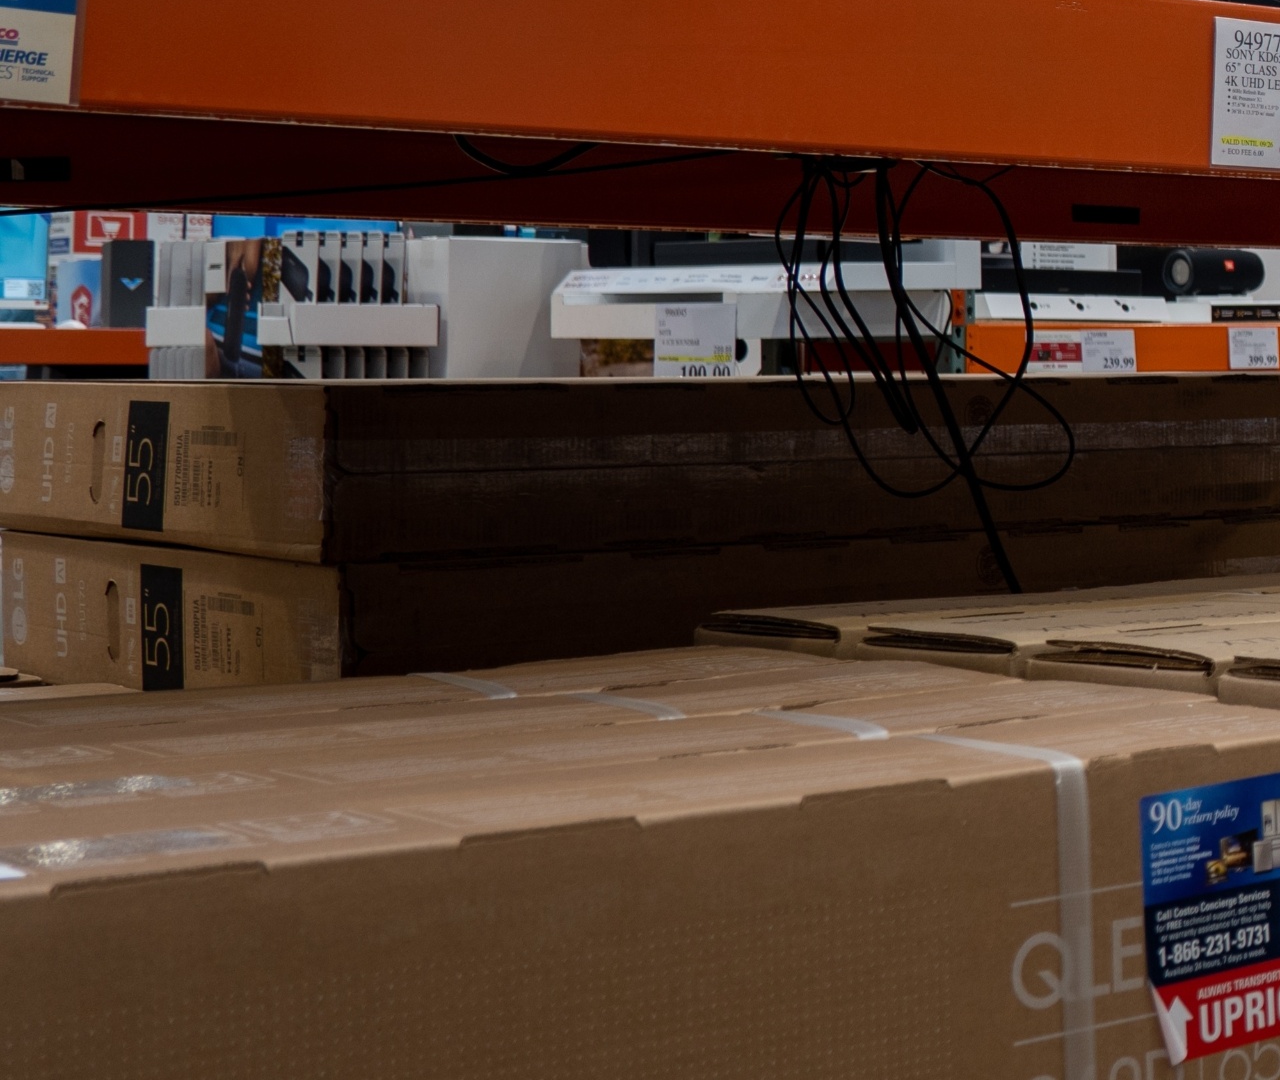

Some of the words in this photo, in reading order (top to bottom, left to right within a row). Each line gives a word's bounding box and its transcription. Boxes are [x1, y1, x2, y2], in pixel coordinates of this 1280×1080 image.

[1225, 62, 1241, 73] 65"
[1245, 64, 1278, 77] CLASS
[1226, 48, 1256, 60] SONY
[1225, 75, 1238, 87] 4K
[1241, 77, 1265, 89] UHD
[1103, 357, 1134, 369] 239.99
[1248, 354, 1278, 367] 399.99
[42, 437, 54, 503] UHD
[126, 424, 154, 506] 55"
[13, 558, 24, 600] LG
[57, 592, 68, 657] UHD
[145, 588, 170, 671] 55"
[1156, 910, 1171, 921] Call
[1174, 905, 1199, 919] Costco
[1200, 896, 1236, 913] Concierge
[1238, 889, 1270, 905] Services
[1158, 923, 1270, 967] 1-866-231-9731
[1197, 979, 1232, 1000] ALWAYS
[1234, 969, 1280, 992] TRANSPORT
